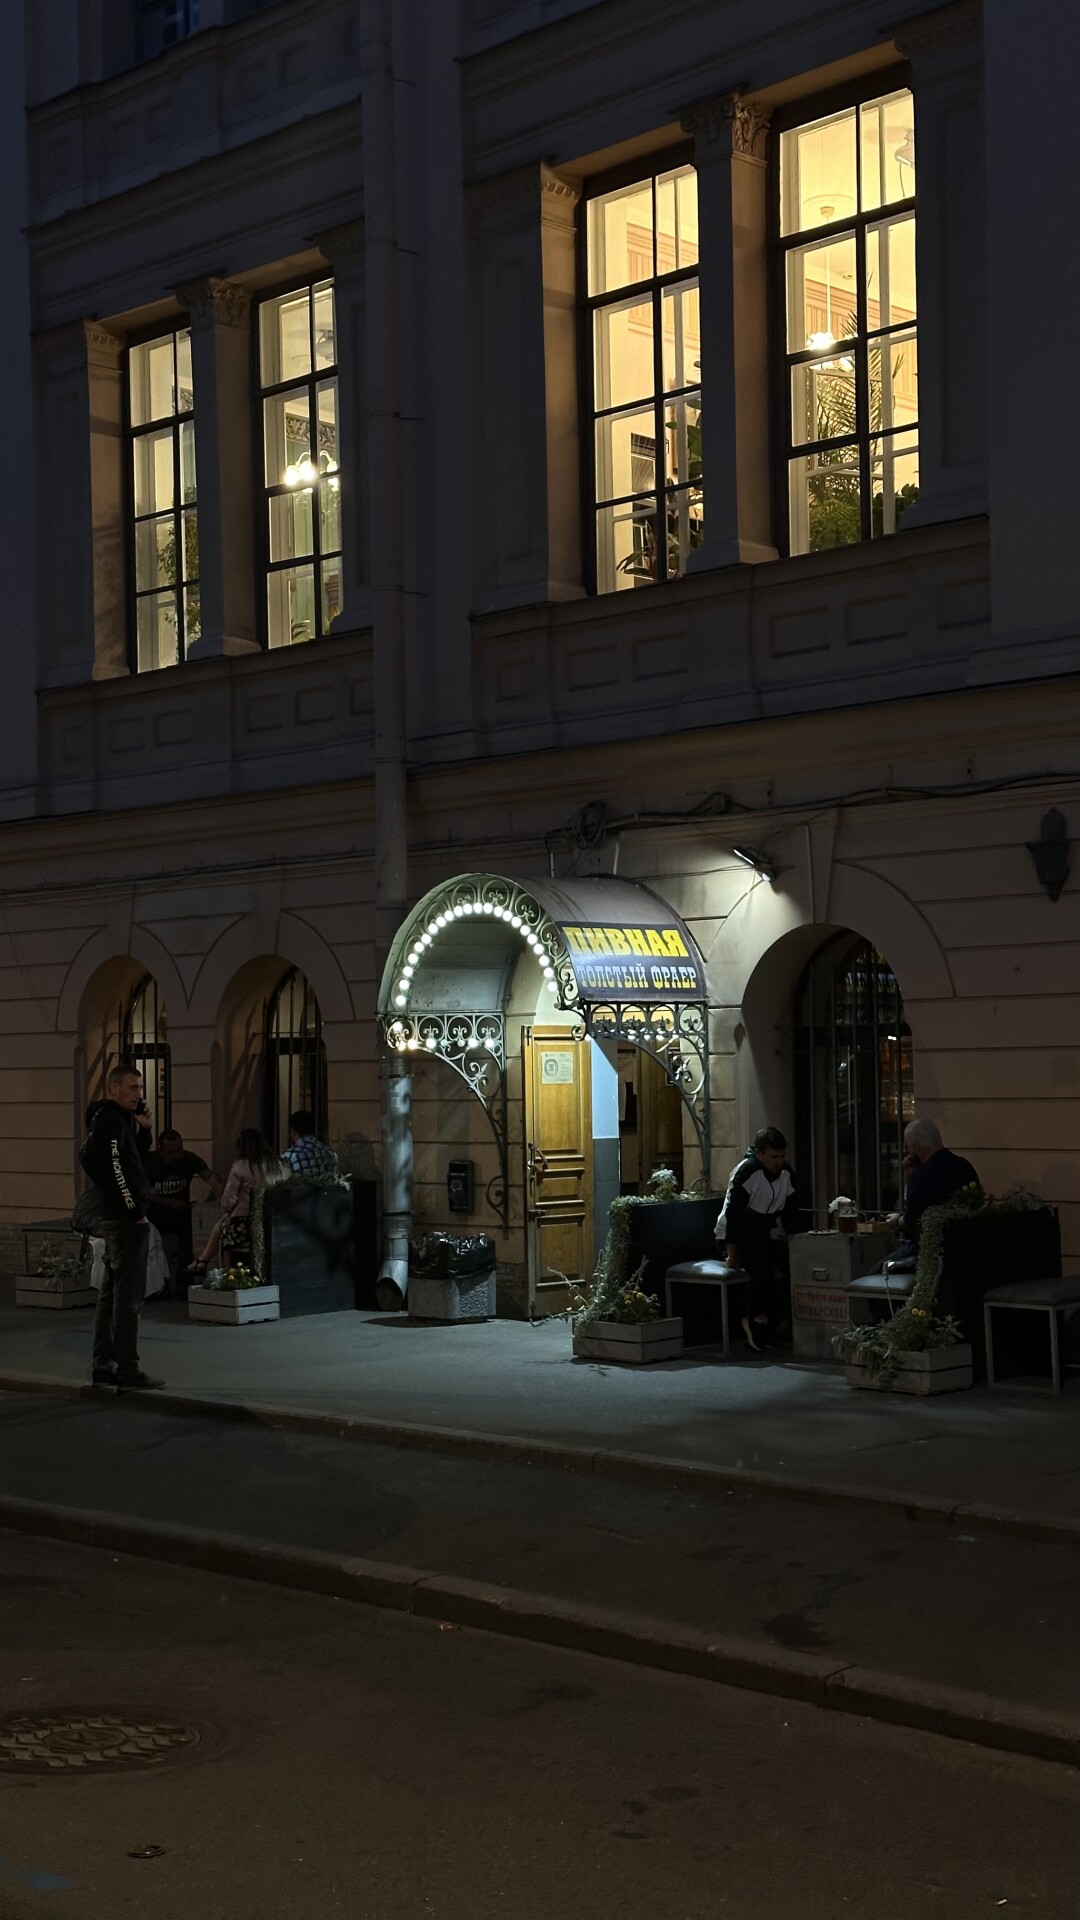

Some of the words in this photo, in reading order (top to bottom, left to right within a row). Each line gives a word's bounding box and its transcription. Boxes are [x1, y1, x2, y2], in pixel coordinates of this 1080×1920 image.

[562, 927, 689, 957] ПИВНАЯ
[576, 963, 649, 989] ТОЛСТЫЙ
[651, 966, 697, 990] ФРАЕР
[110, 1139, 120, 1156] THE
[112, 1158, 126, 1188] NORTH
[121, 1188, 136, 1210] FACE
